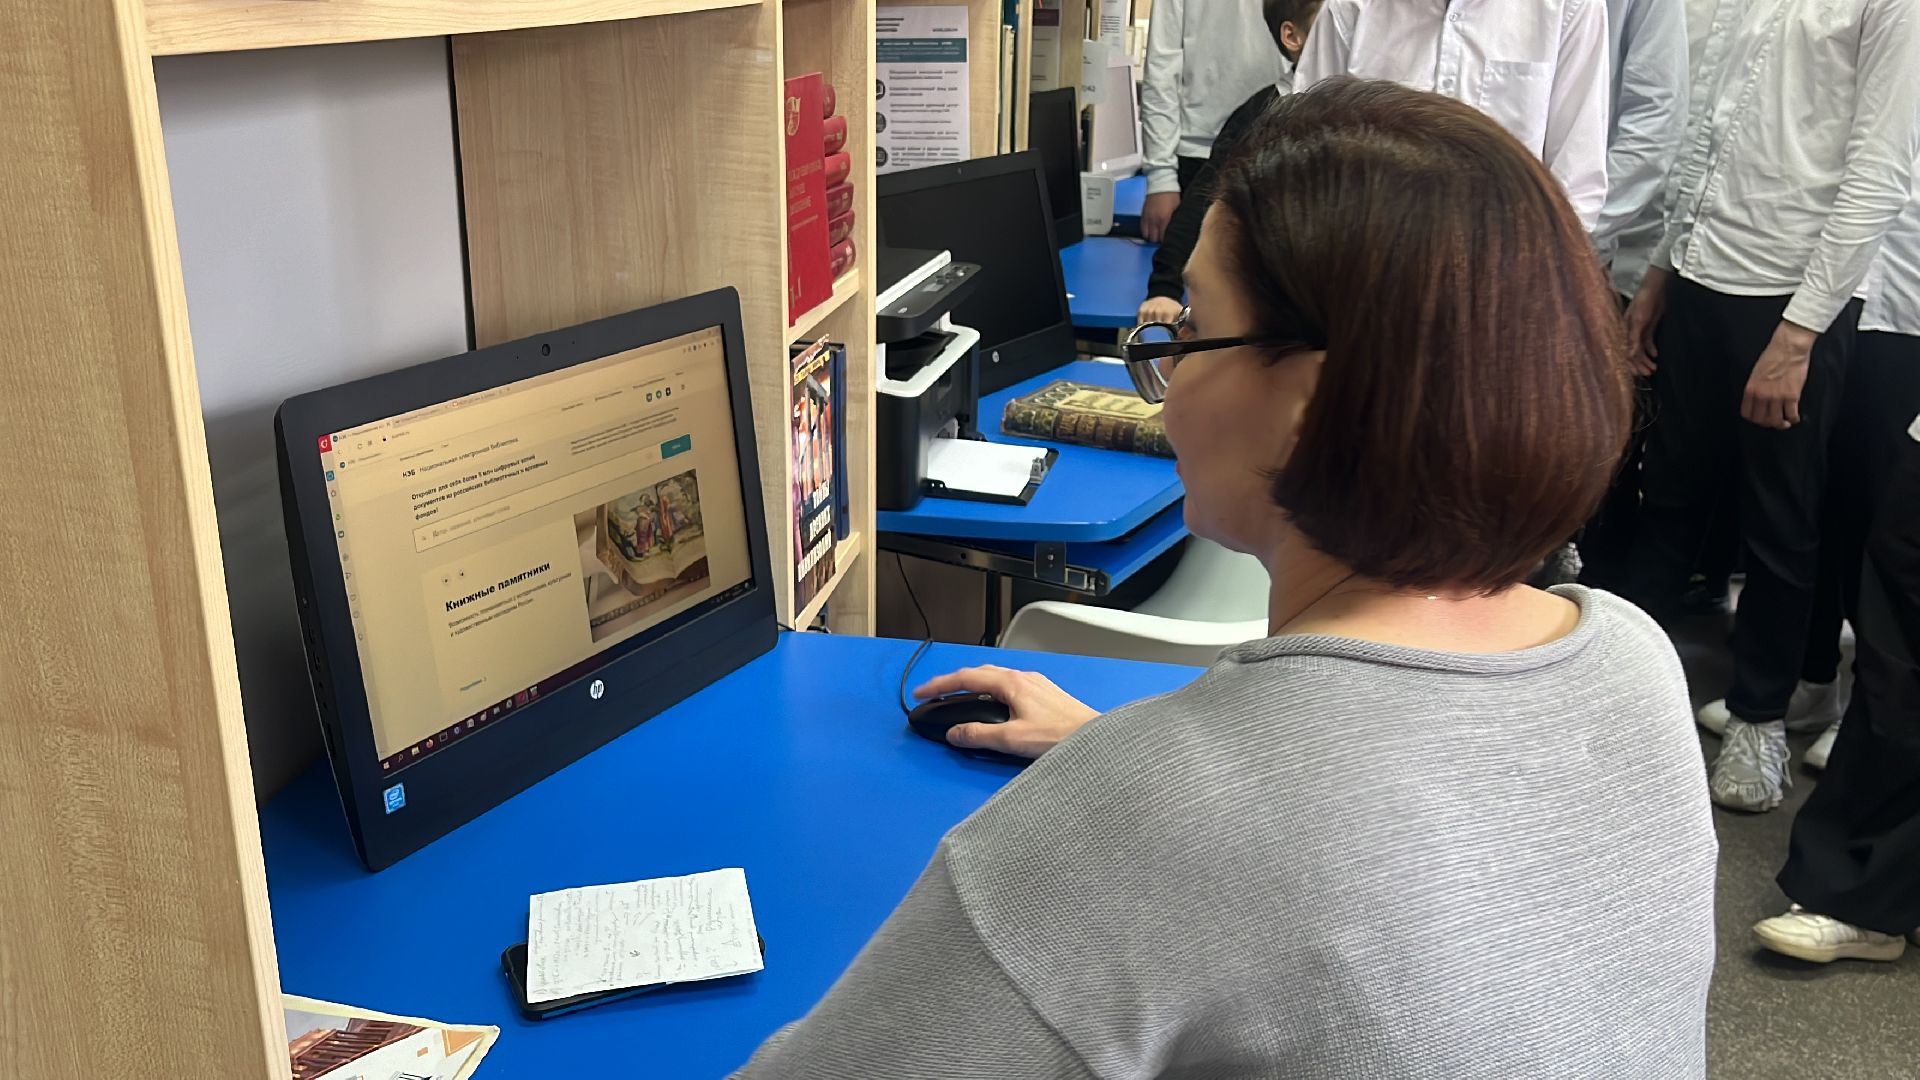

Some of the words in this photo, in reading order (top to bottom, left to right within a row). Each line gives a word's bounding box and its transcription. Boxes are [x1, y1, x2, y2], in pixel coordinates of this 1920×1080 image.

[411, 488, 437, 501] Откройте
[438, 483, 448, 493] для
[449, 479, 461, 488] себя
[462, 474, 478, 483] более
[413, 495, 445, 511] документов
[453, 482, 483, 499] российских
[445, 585, 495, 612] Книжные
[498, 562, 551, 591] памятники
